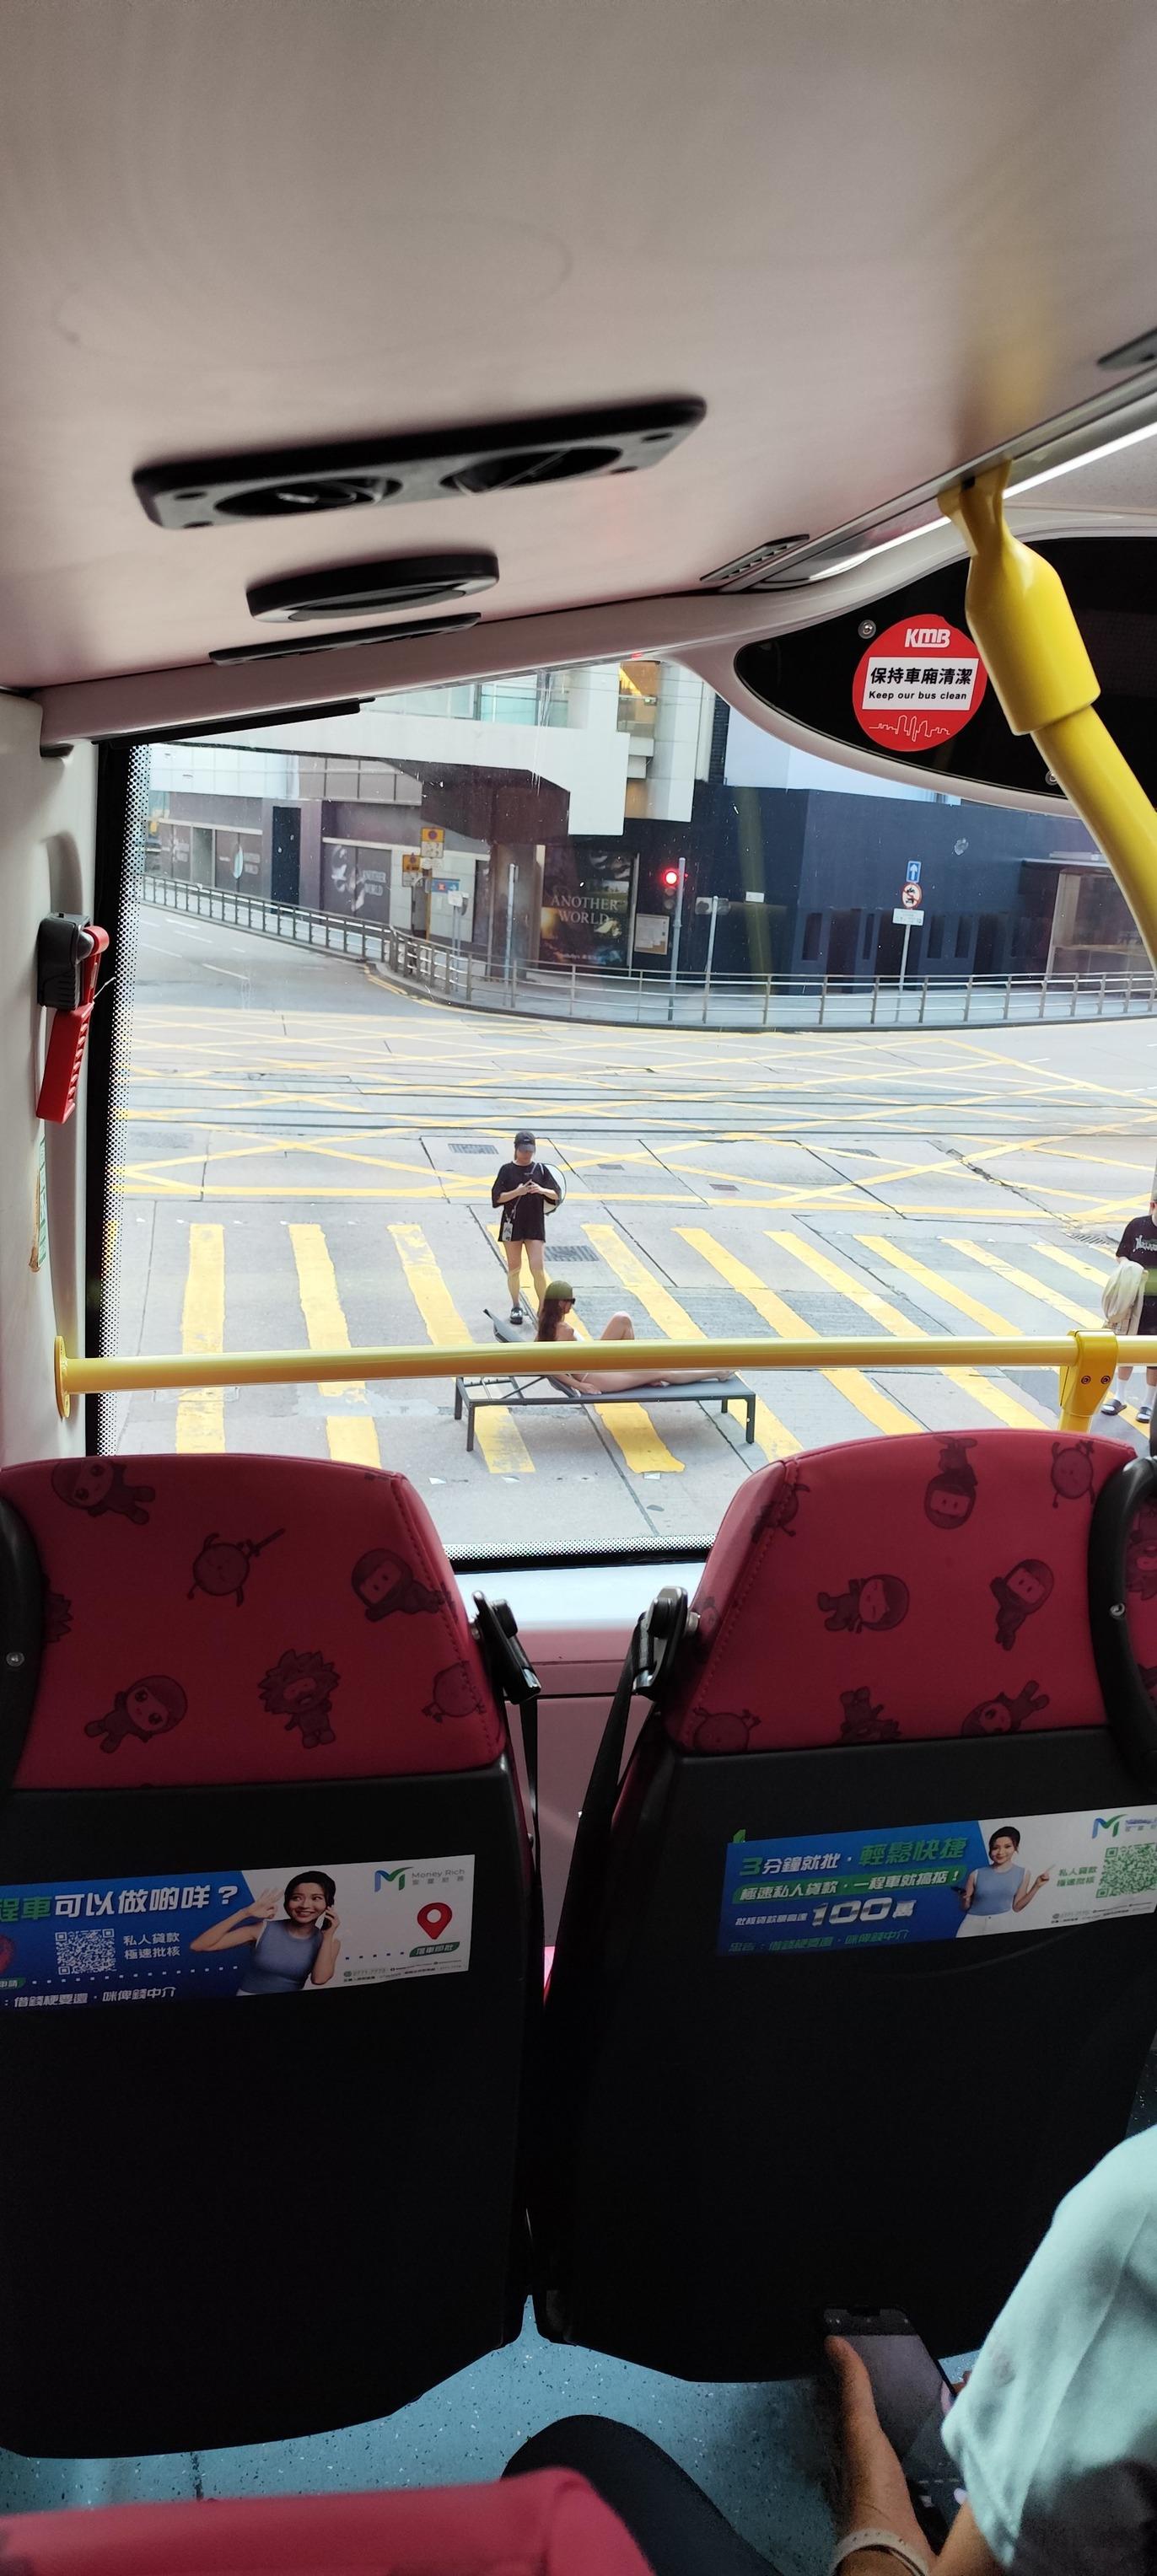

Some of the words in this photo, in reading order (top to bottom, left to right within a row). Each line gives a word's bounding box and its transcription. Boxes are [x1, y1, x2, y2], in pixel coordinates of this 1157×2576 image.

[904, 628, 951, 648] KMB
[870, 667, 973, 685] 保持車廂清潔
[869, 690, 894, 700] Keep
[918, 691, 936, 700] bus
[939, 691, 967, 700] clean
[551, 894, 619, 911] ANOTHER
[557, 910, 610, 925] WORLD
[412, 1870, 443, 1879] Money
[445, 1868, 465, 1876] Rich
[123, 1931, 180, 1946] 私人貸款
[124, 1945, 180, 1961] 極速批核
